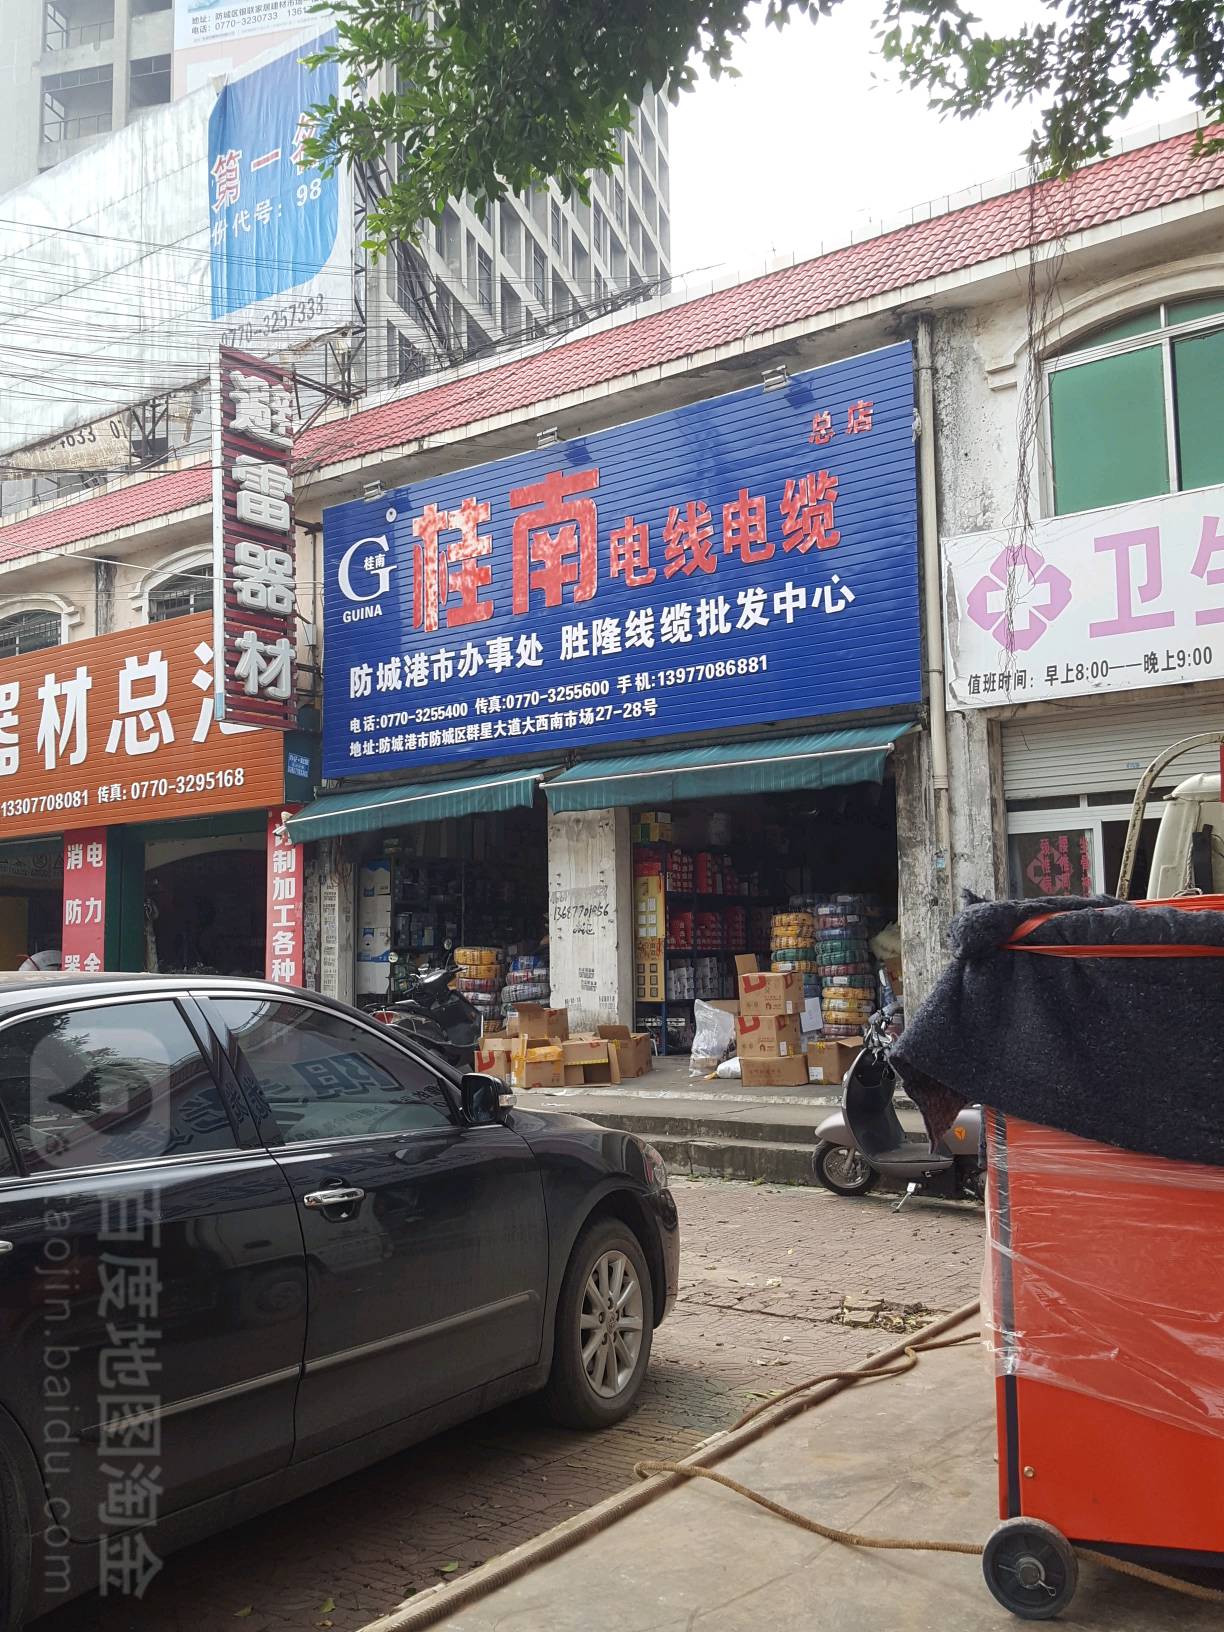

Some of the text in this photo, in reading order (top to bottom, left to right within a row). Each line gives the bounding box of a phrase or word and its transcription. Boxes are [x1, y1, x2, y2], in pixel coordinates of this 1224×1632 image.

[808, 400, 874, 445] 总店
[229, 369, 296, 700] 避雷器材
[363, 553, 386, 571] 桂南
[412, 468, 842, 632] 桂南 电线电缆
[342, 604, 383, 623] GUINA
[350, 573, 856, 699] 防城港市办事处 胜隆线缆批发中心
